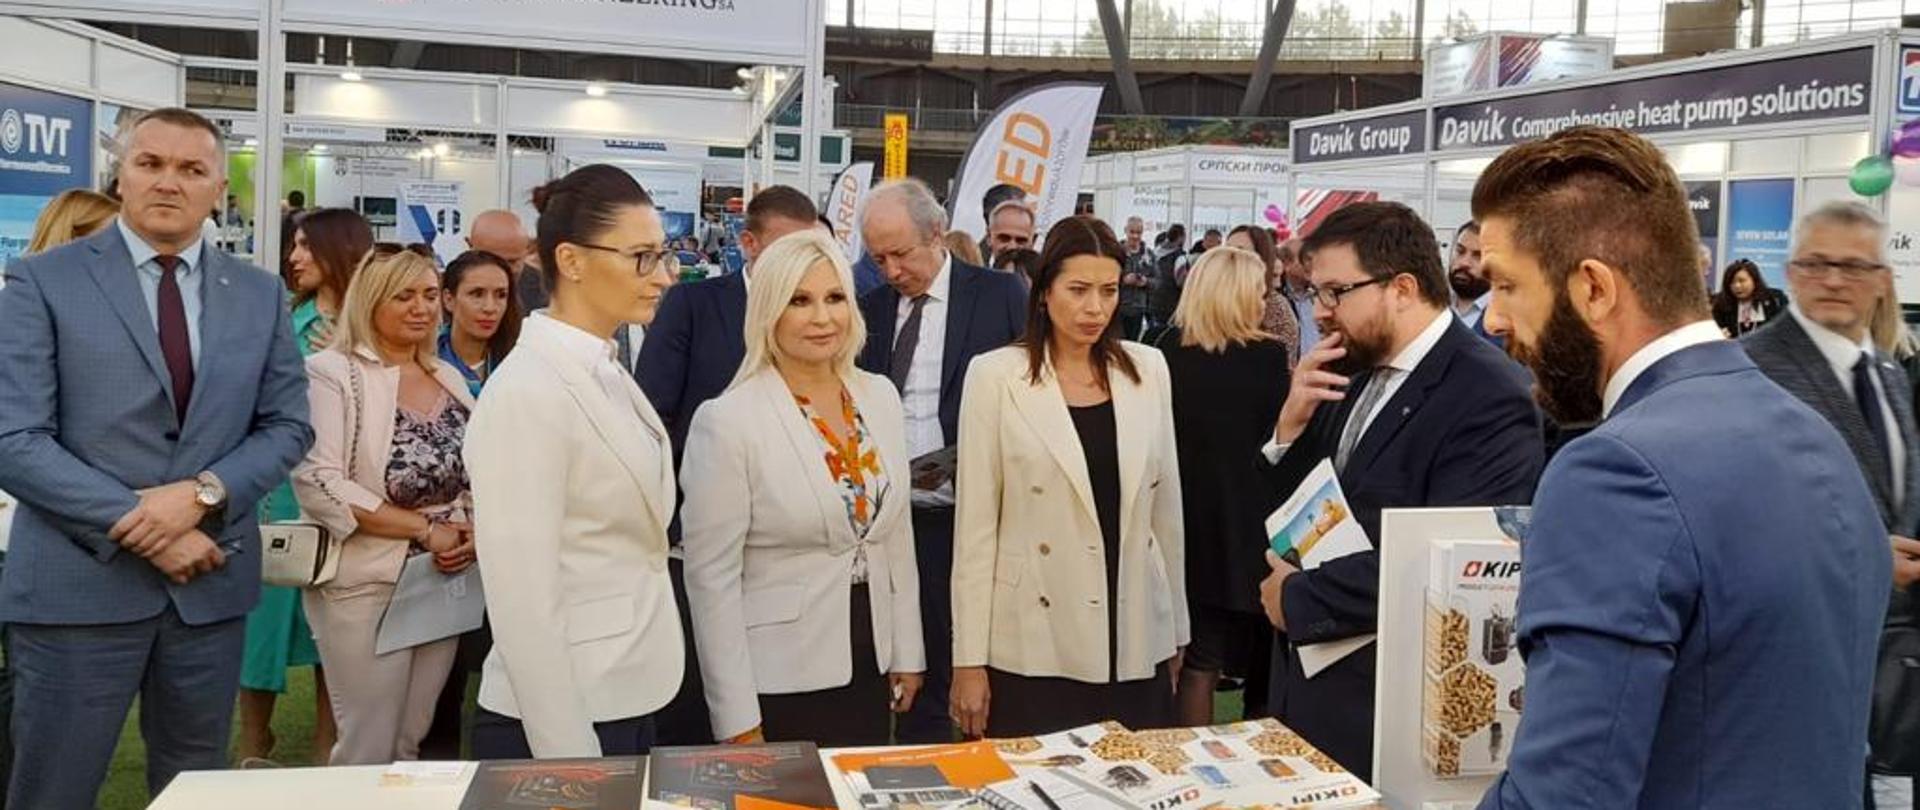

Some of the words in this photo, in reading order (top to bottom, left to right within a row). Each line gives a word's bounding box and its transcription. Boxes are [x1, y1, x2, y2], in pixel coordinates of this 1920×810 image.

[1638, 101, 1682, 127] heat
[1684, 94, 1749, 128] pump
[1751, 80, 1864, 117] solutions
[24, 112, 72, 157] TVT
[1360, 125, 1411, 152] Group
[995, 111, 1052, 197] ED
[1482, 561, 1522, 577] KIP
[1292, 788, 1339, 805] KIPI
